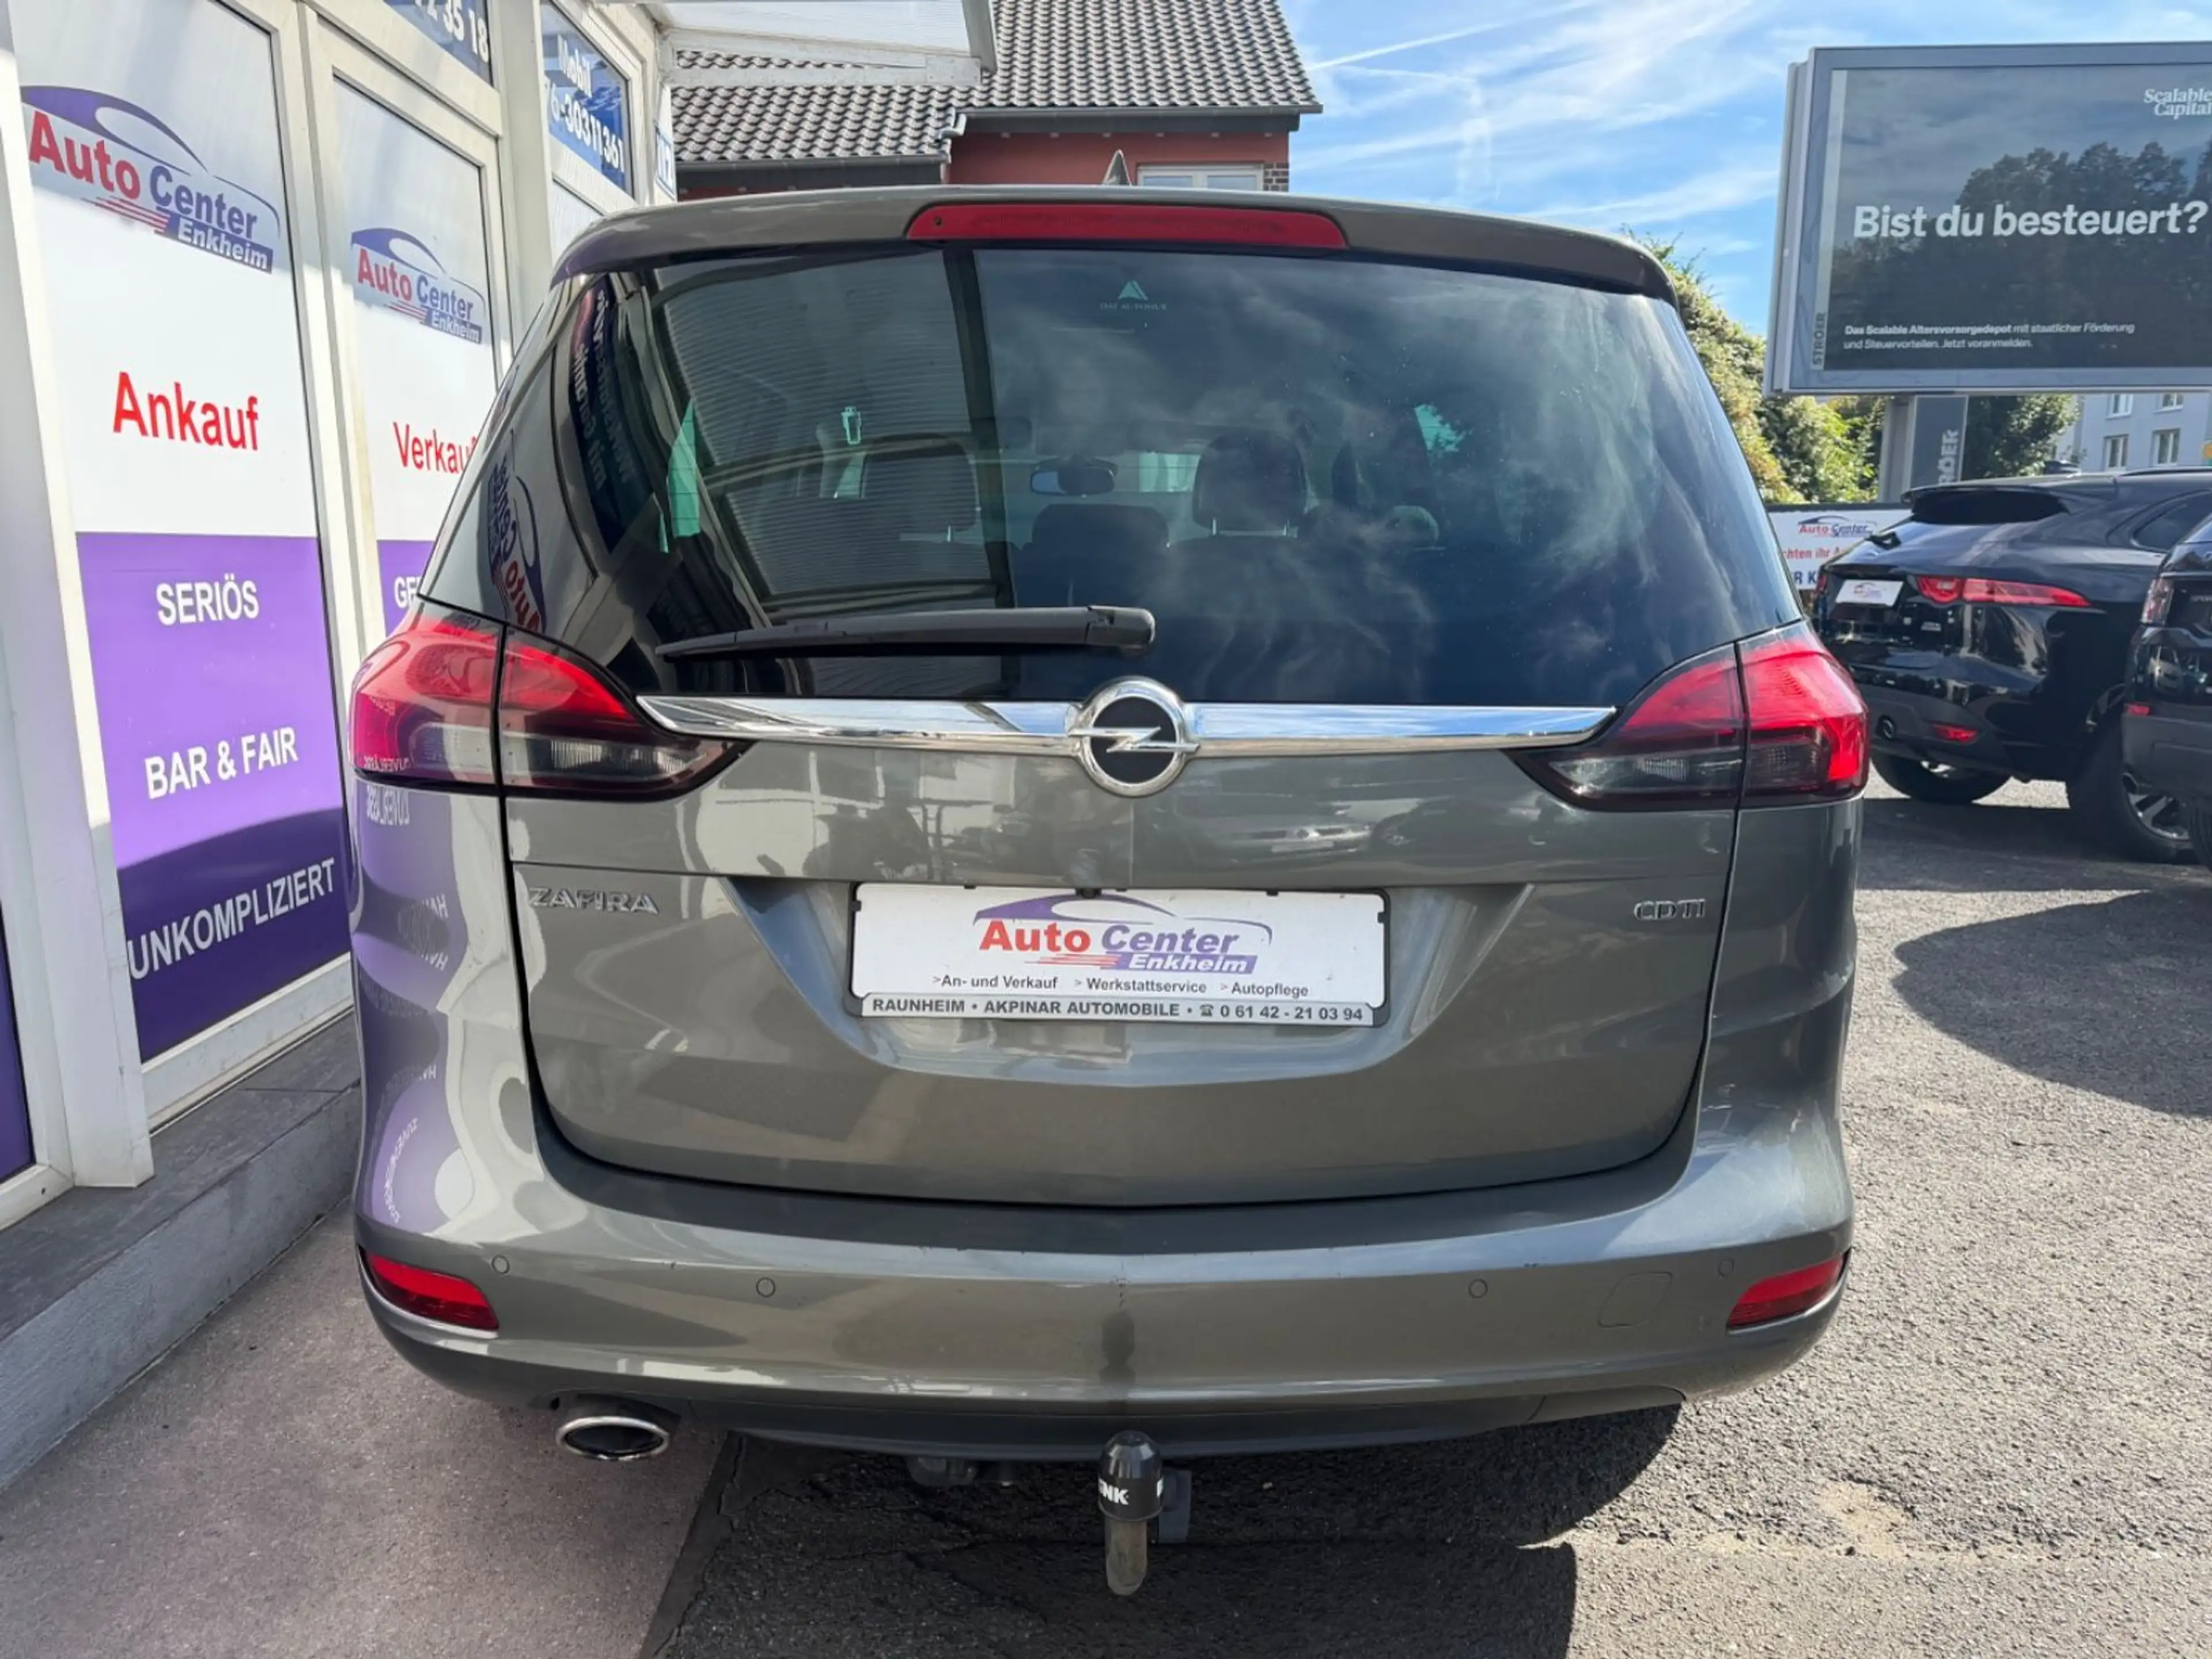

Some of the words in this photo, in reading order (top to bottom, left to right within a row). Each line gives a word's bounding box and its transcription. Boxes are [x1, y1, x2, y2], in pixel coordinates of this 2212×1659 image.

[468, 8, 488, 63] 18
[2143, 88, 2212, 103] Scalable
[2154, 103, 2212, 120] Capital
[29, 110, 140, 199] Auto
[149, 165, 257, 238] Center
[1854, 206, 1927, 237] Bist
[1936, 205, 1983, 237] du
[1993, 201, 2208, 236] besteuert?
[177, 218, 268, 270] Enkheim
[358, 248, 412, 301] Auto
[417, 274, 473, 320] Center
[432, 310, 479, 342] Enkheim
[1844, 325, 1864, 335] Das
[1866, 325, 1907, 335] Scalable
[2013, 324, 2029, 333] mit
[2084, 323, 2135, 334] Förderung
[1844, 339, 1863, 349] und
[113, 372, 259, 450] Ankauf
[393, 422, 477, 474] Verkau
[1799, 524, 1829, 533] Auto
[1832, 523, 1868, 534] Center
[156, 574, 259, 625] SERIÖS
[144, 746, 211, 799] BAR
[217, 741, 236, 779] &
[242, 727, 298, 774] FAIR
[529, 887, 659, 915] ZAFIRA
[1634, 898, 1706, 920] CDTI
[127, 858, 335, 980] UNKOMPLIZIERT
[979, 919, 1091, 952] Auto
[1101, 925, 1240, 953] Center
[1128, 953, 1247, 972] Enkheim
[971, 975, 998, 987] und
[1003, 976, 1058, 989] Verkauf
[1086, 978, 1206, 993] Werkstattservice
[1232, 982, 1309, 998] Autopflege
[873, 999, 964, 1013] RAUNHEIM
[984, 1001, 1061, 1014] AKPINAR
[1067, 1002, 1180, 1016] AUTOMOBILE
[1221, 1005, 1230, 1017] 0
[1235, 1005, 1253, 1018] 61
[1260, 1006, 1279, 1018] 42
[1294, 1006, 1312, 1019] 21
[1318, 1007, 1338, 1020] 03
[1343, 1008, 1363, 1020] 94
